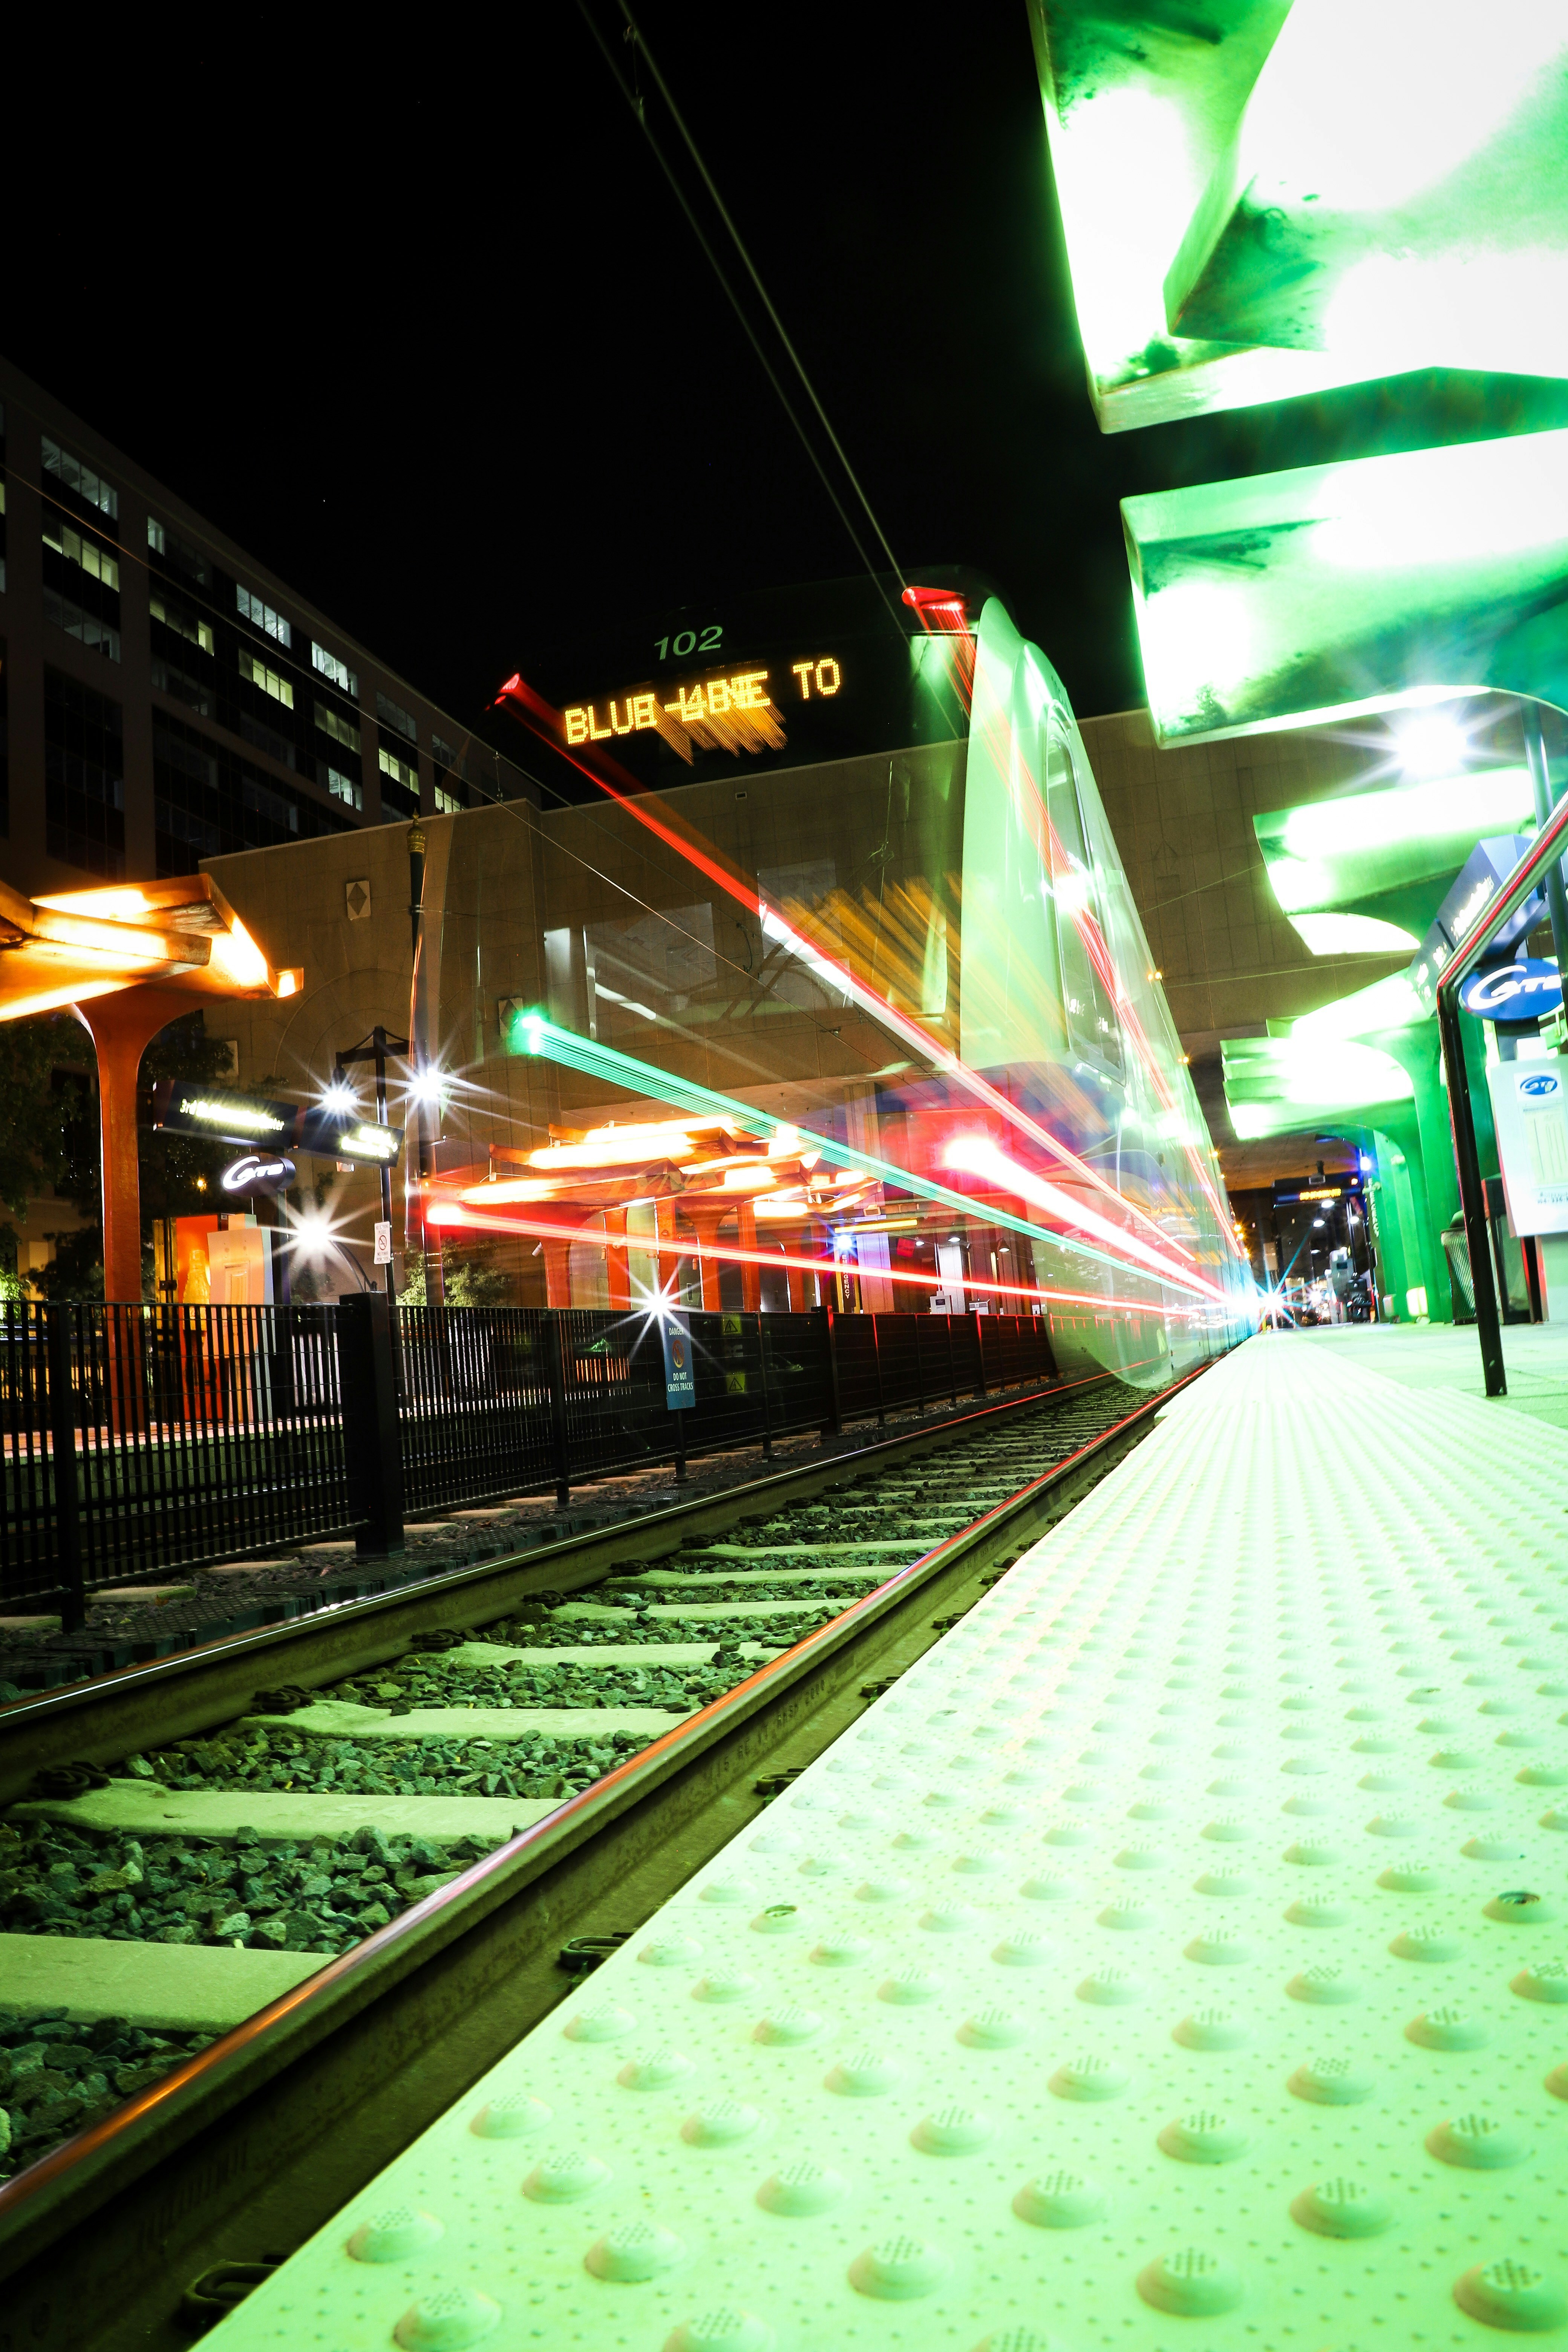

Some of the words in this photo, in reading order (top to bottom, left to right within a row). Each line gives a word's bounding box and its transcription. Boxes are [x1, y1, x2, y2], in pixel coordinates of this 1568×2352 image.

[654, 625, 723, 660] 102
[793, 658, 840, 699] TO
[180, 1098, 197, 1115] 3rd
[669, 1327, 684, 1335] DANGER
[673, 1372, 679, 1381] DO
[668, 1383, 680, 1392] CROSS
[680, 1382, 693, 1391] TRACKS
